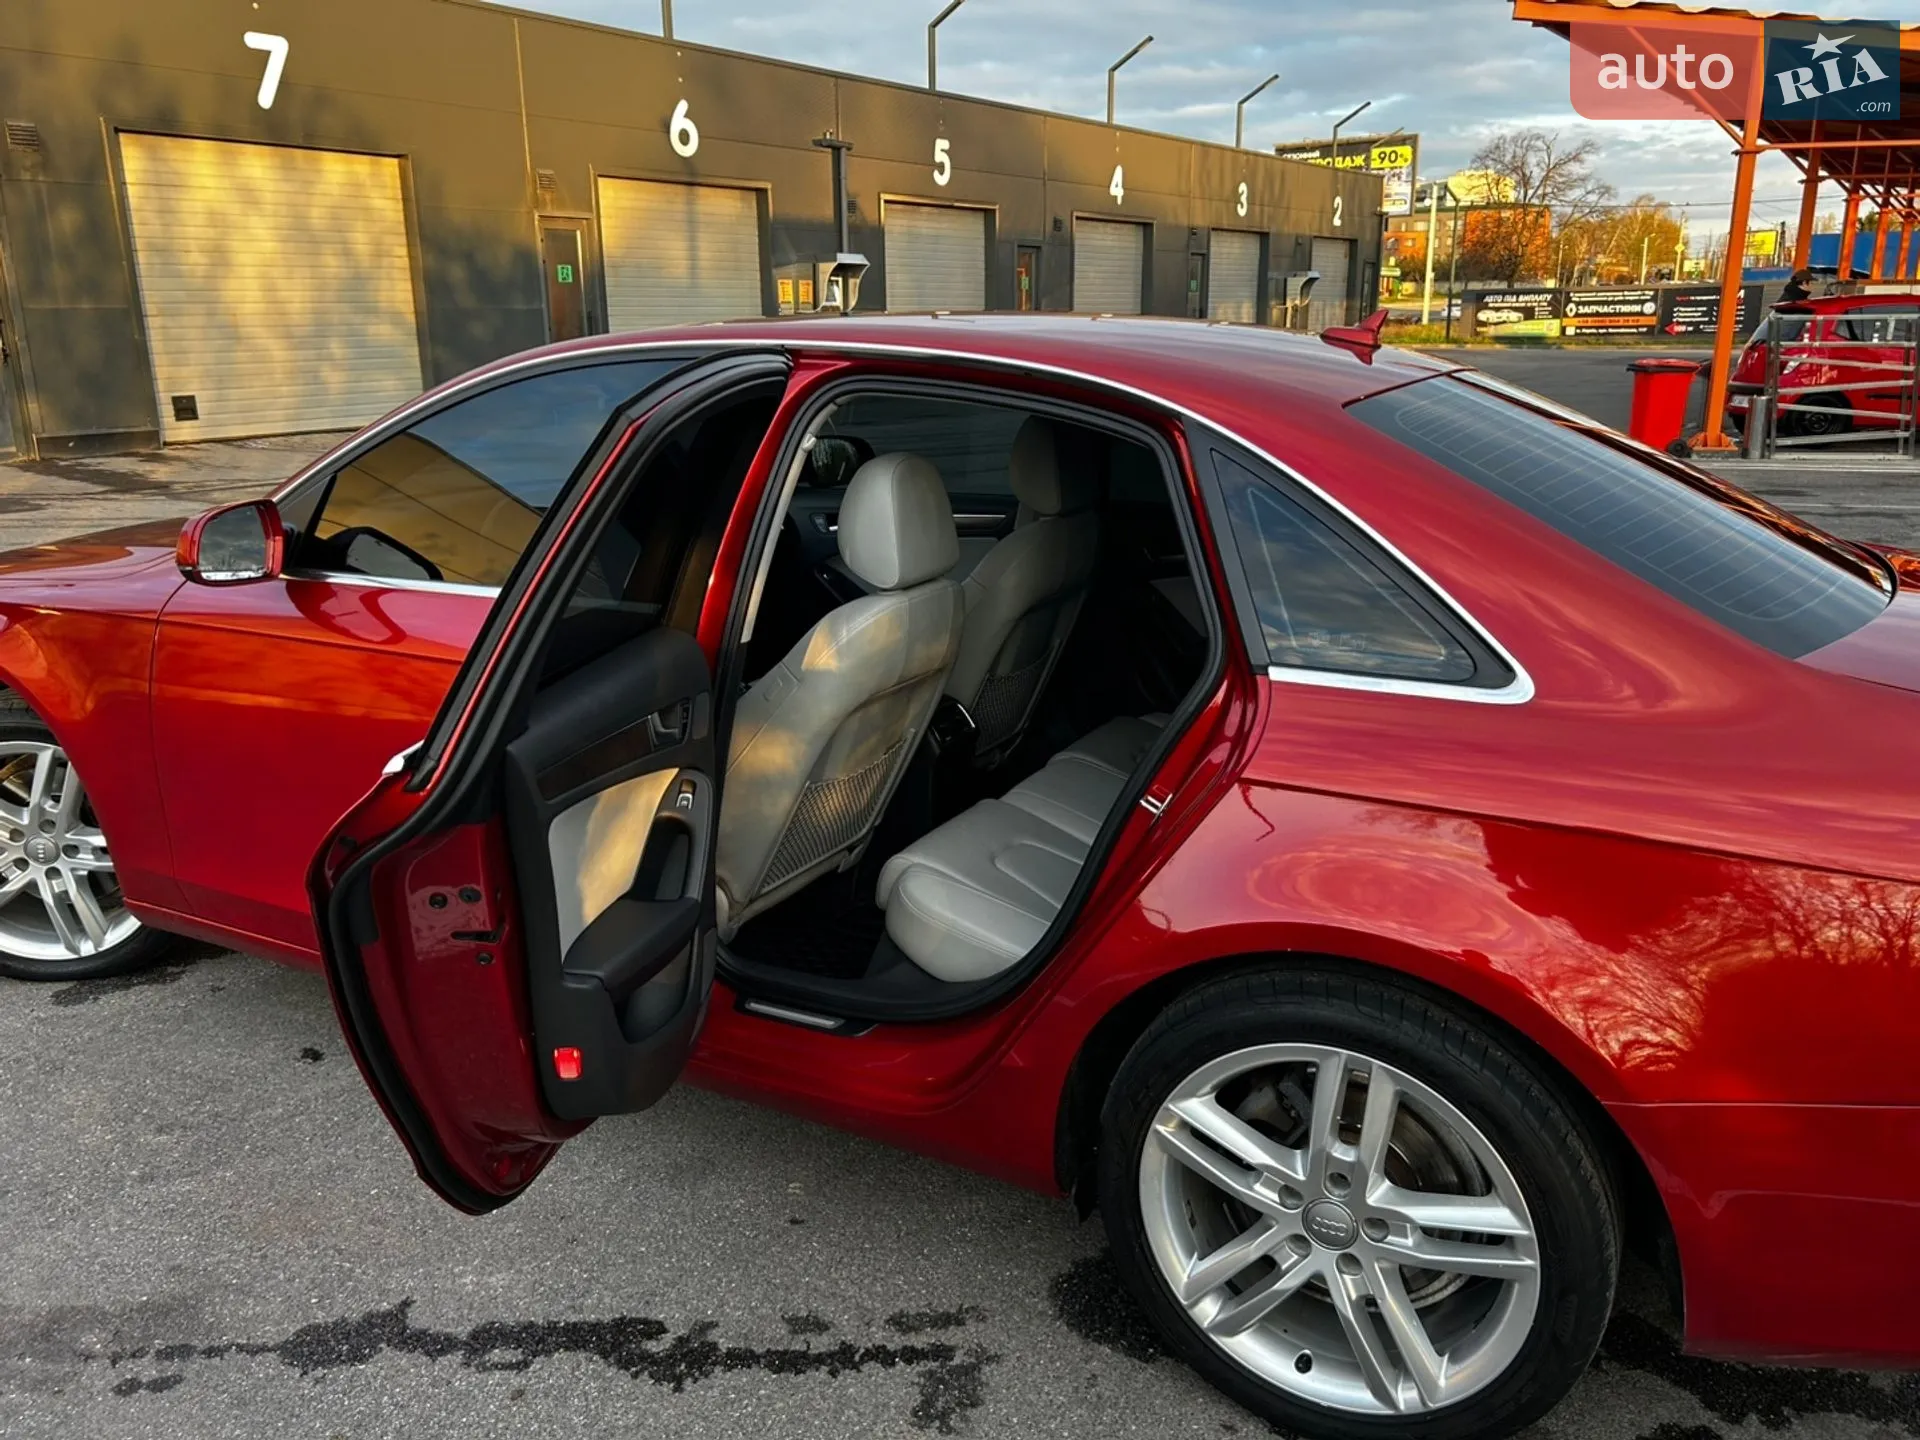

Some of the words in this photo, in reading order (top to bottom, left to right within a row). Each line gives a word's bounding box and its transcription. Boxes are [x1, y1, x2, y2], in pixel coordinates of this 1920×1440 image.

[243, 31, 289, 110] 7
[669, 98, 699, 158] 6
[932, 138, 952, 187] 5
[1109, 164, 1125, 205] 4
[1236, 181, 1249, 217] 3
[1332, 195, 1343, 227] 2
